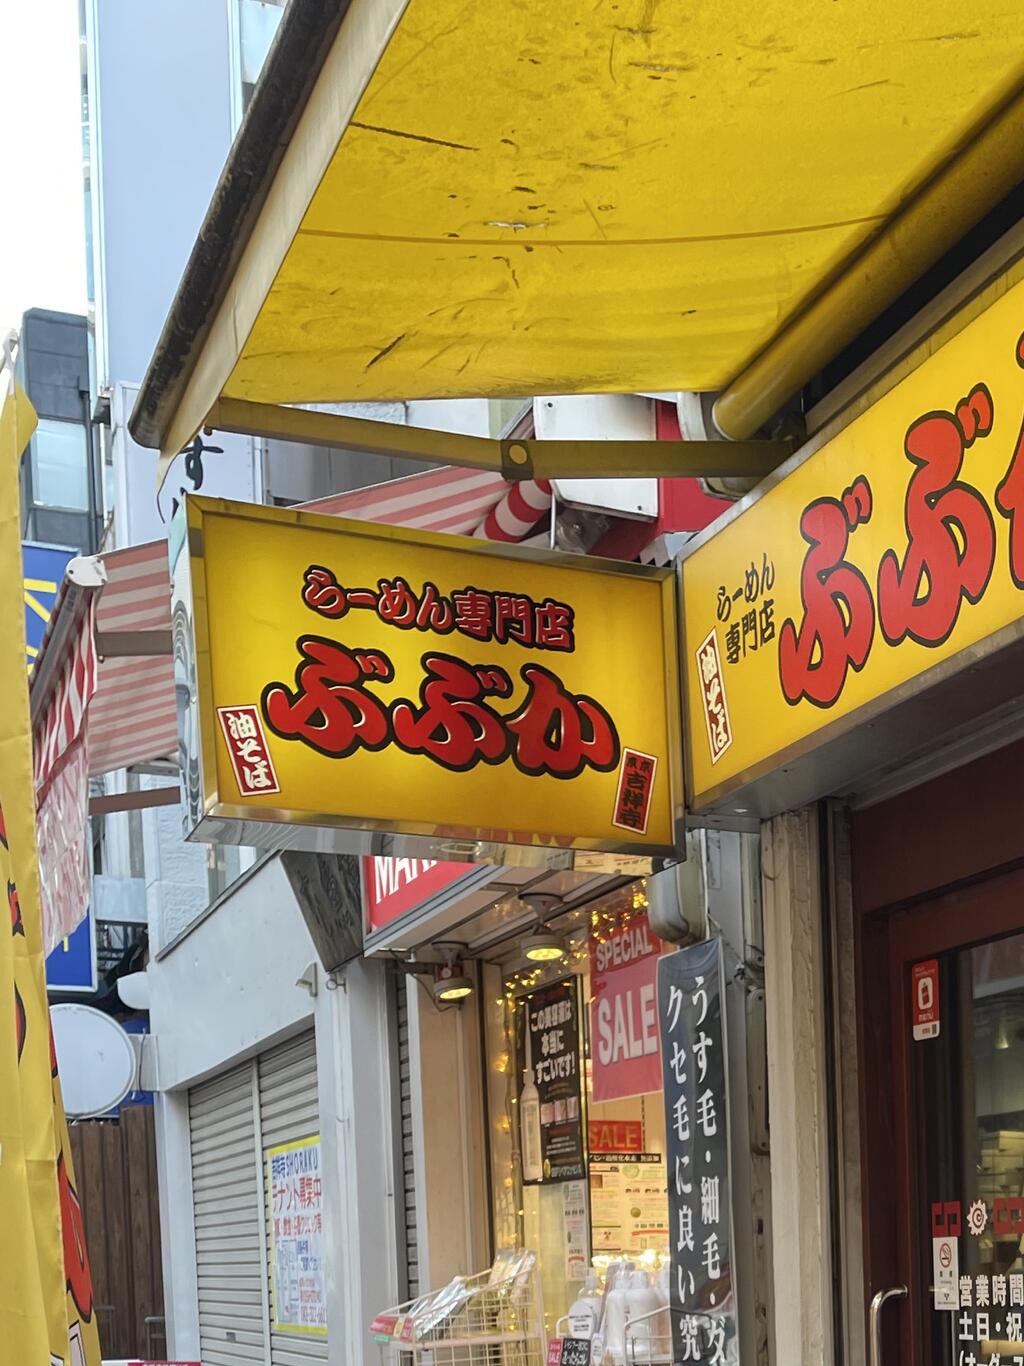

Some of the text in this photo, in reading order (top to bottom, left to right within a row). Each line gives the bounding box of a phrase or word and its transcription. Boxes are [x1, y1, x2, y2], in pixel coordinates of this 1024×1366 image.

[302, 564, 575, 653] らーめん専門店
[717, 552, 775, 623] らーめん
[725, 599, 776, 664] 専門店
[260, 634, 621, 779] ぶぶか
[701, 644, 729, 752] 油そば
[227, 711, 273, 790] 油そば
[619, 772, 650, 827] 吉祥寺
[596, 922, 653, 971] SPECIAL
[598, 983, 658, 1065] SALE
[535, 1051, 576, 1084] すごいです!
[589, 1125, 638, 1149] SALE
